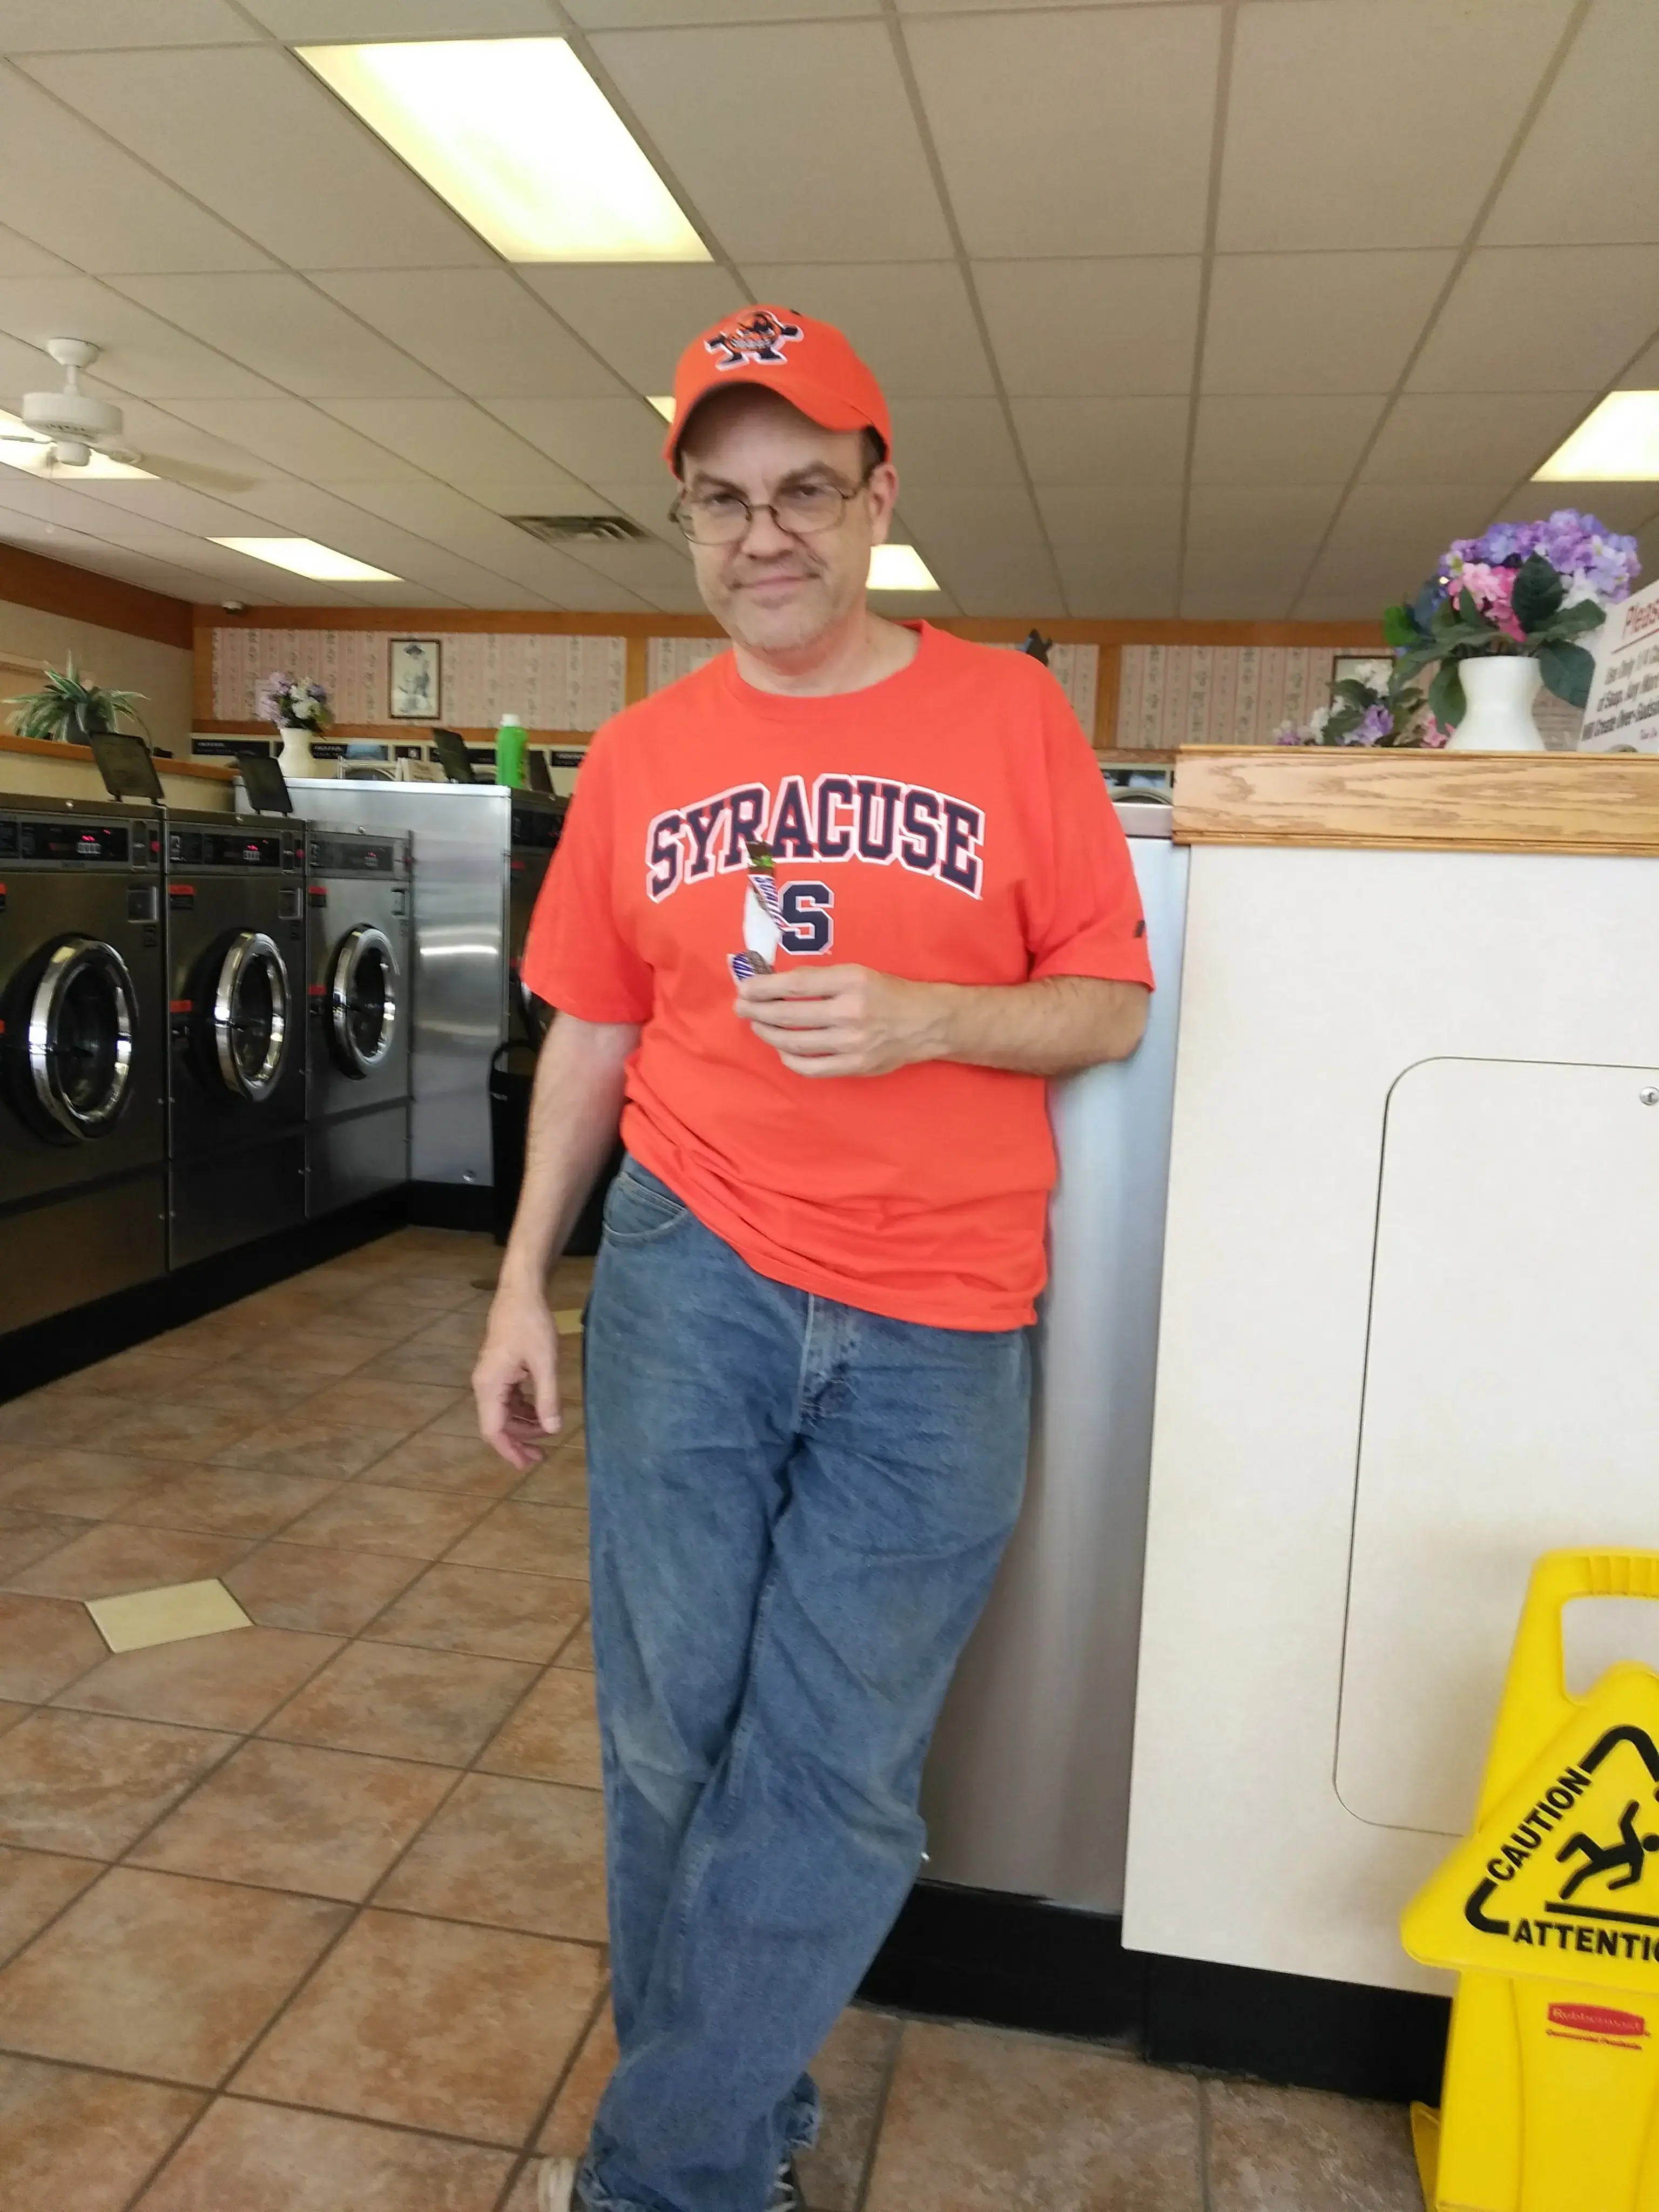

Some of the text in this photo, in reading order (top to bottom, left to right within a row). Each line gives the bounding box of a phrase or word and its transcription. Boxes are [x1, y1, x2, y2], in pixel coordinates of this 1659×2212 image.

[646, 772, 985, 903] SYRACUSE
[778, 880, 834, 955] S
[1487, 1766, 1592, 1881] CAUTION
